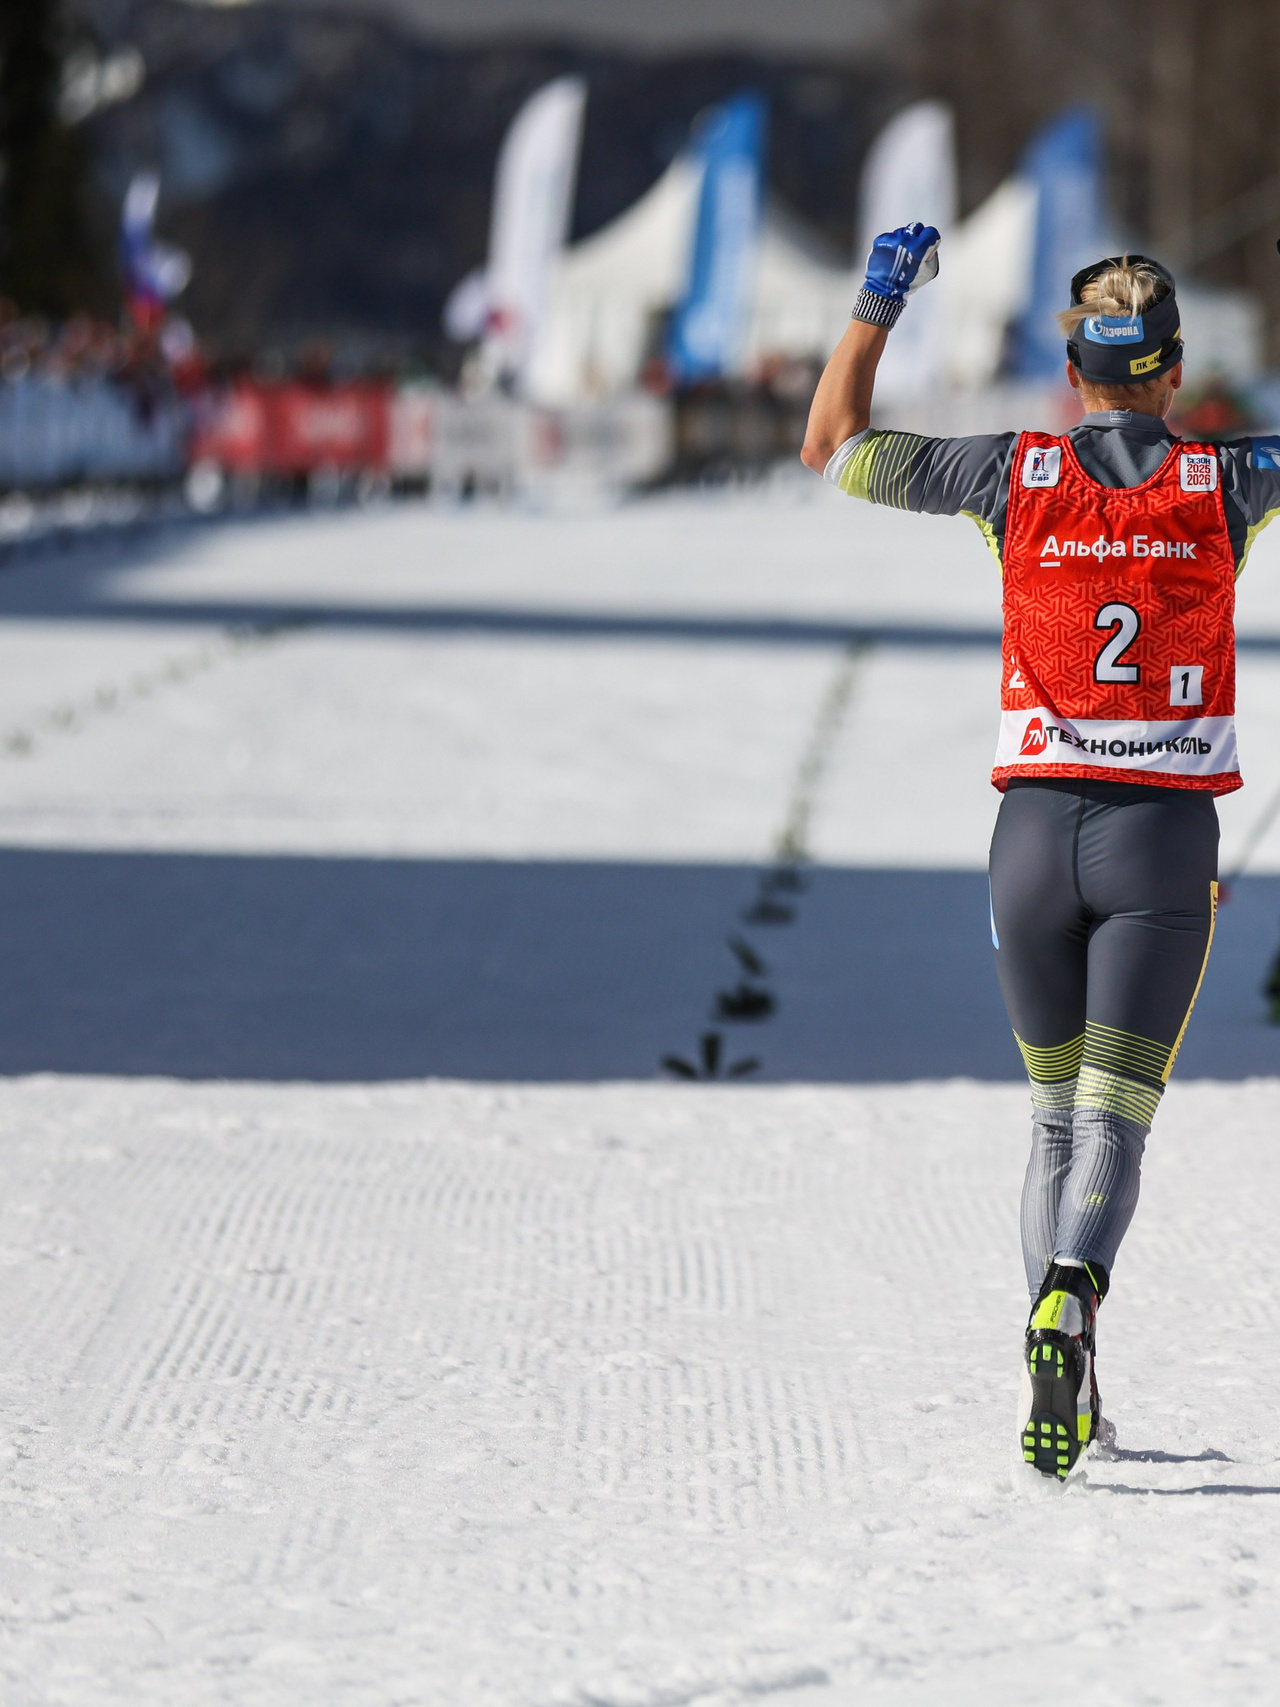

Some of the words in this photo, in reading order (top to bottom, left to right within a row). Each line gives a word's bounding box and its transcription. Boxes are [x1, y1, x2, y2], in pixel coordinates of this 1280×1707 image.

[1136, 361, 1147, 371] ЛК
[1187, 464, 1211, 473] 2025
[1187, 474, 1211, 485] 2026
[1040, 535, 1127, 564] Альфа
[1132, 534, 1197, 559] Банк
[1093, 601, 1141, 684] 2
[1180, 671, 1190, 700] 1
[1045, 726, 1211, 757] ТЕХНОНИКОЛЬ
